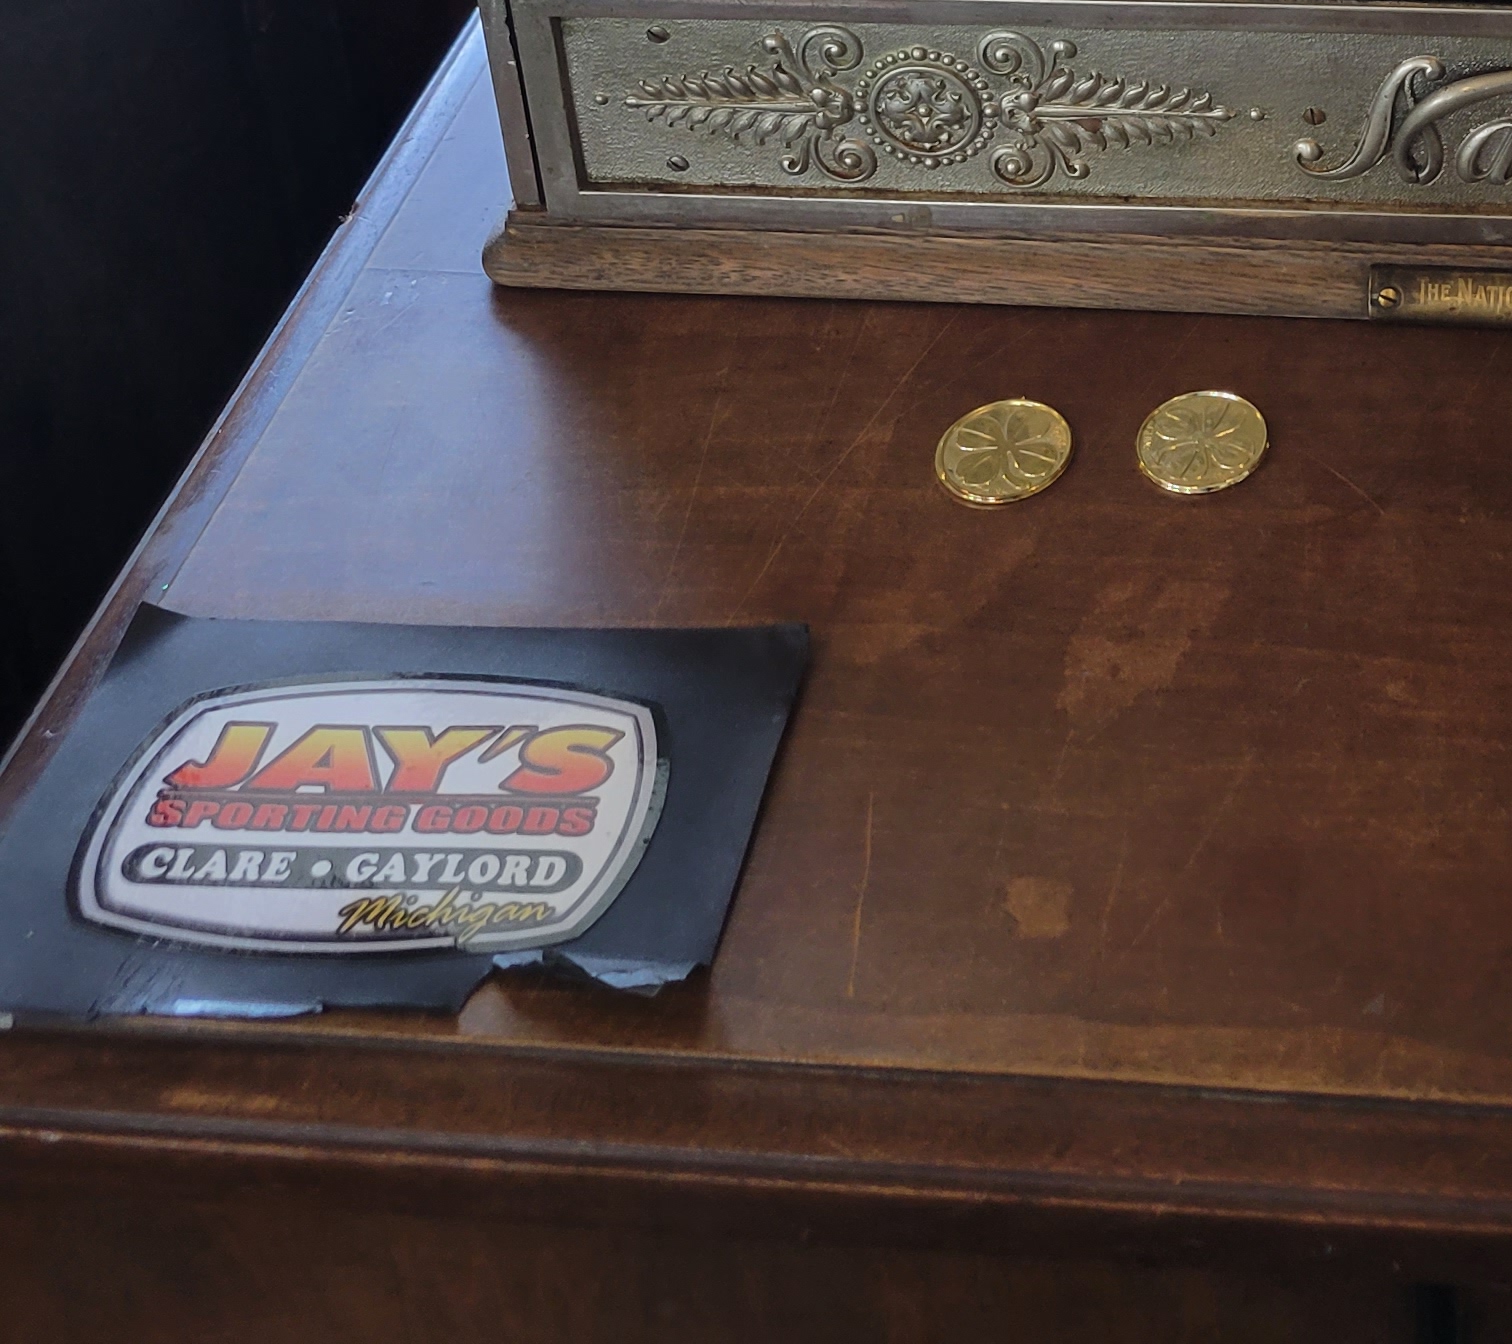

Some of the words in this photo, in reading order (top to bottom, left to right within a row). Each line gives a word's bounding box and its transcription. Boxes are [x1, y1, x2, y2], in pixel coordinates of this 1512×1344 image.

[162, 720, 626, 796] JAY'S
[146, 797, 410, 835] SPORTING
[413, 802, 601, 837] GOODS
[138, 845, 296, 883] CLARE
[345, 852, 569, 887] GAYLORD
[335, 886, 555, 944] Michigan
